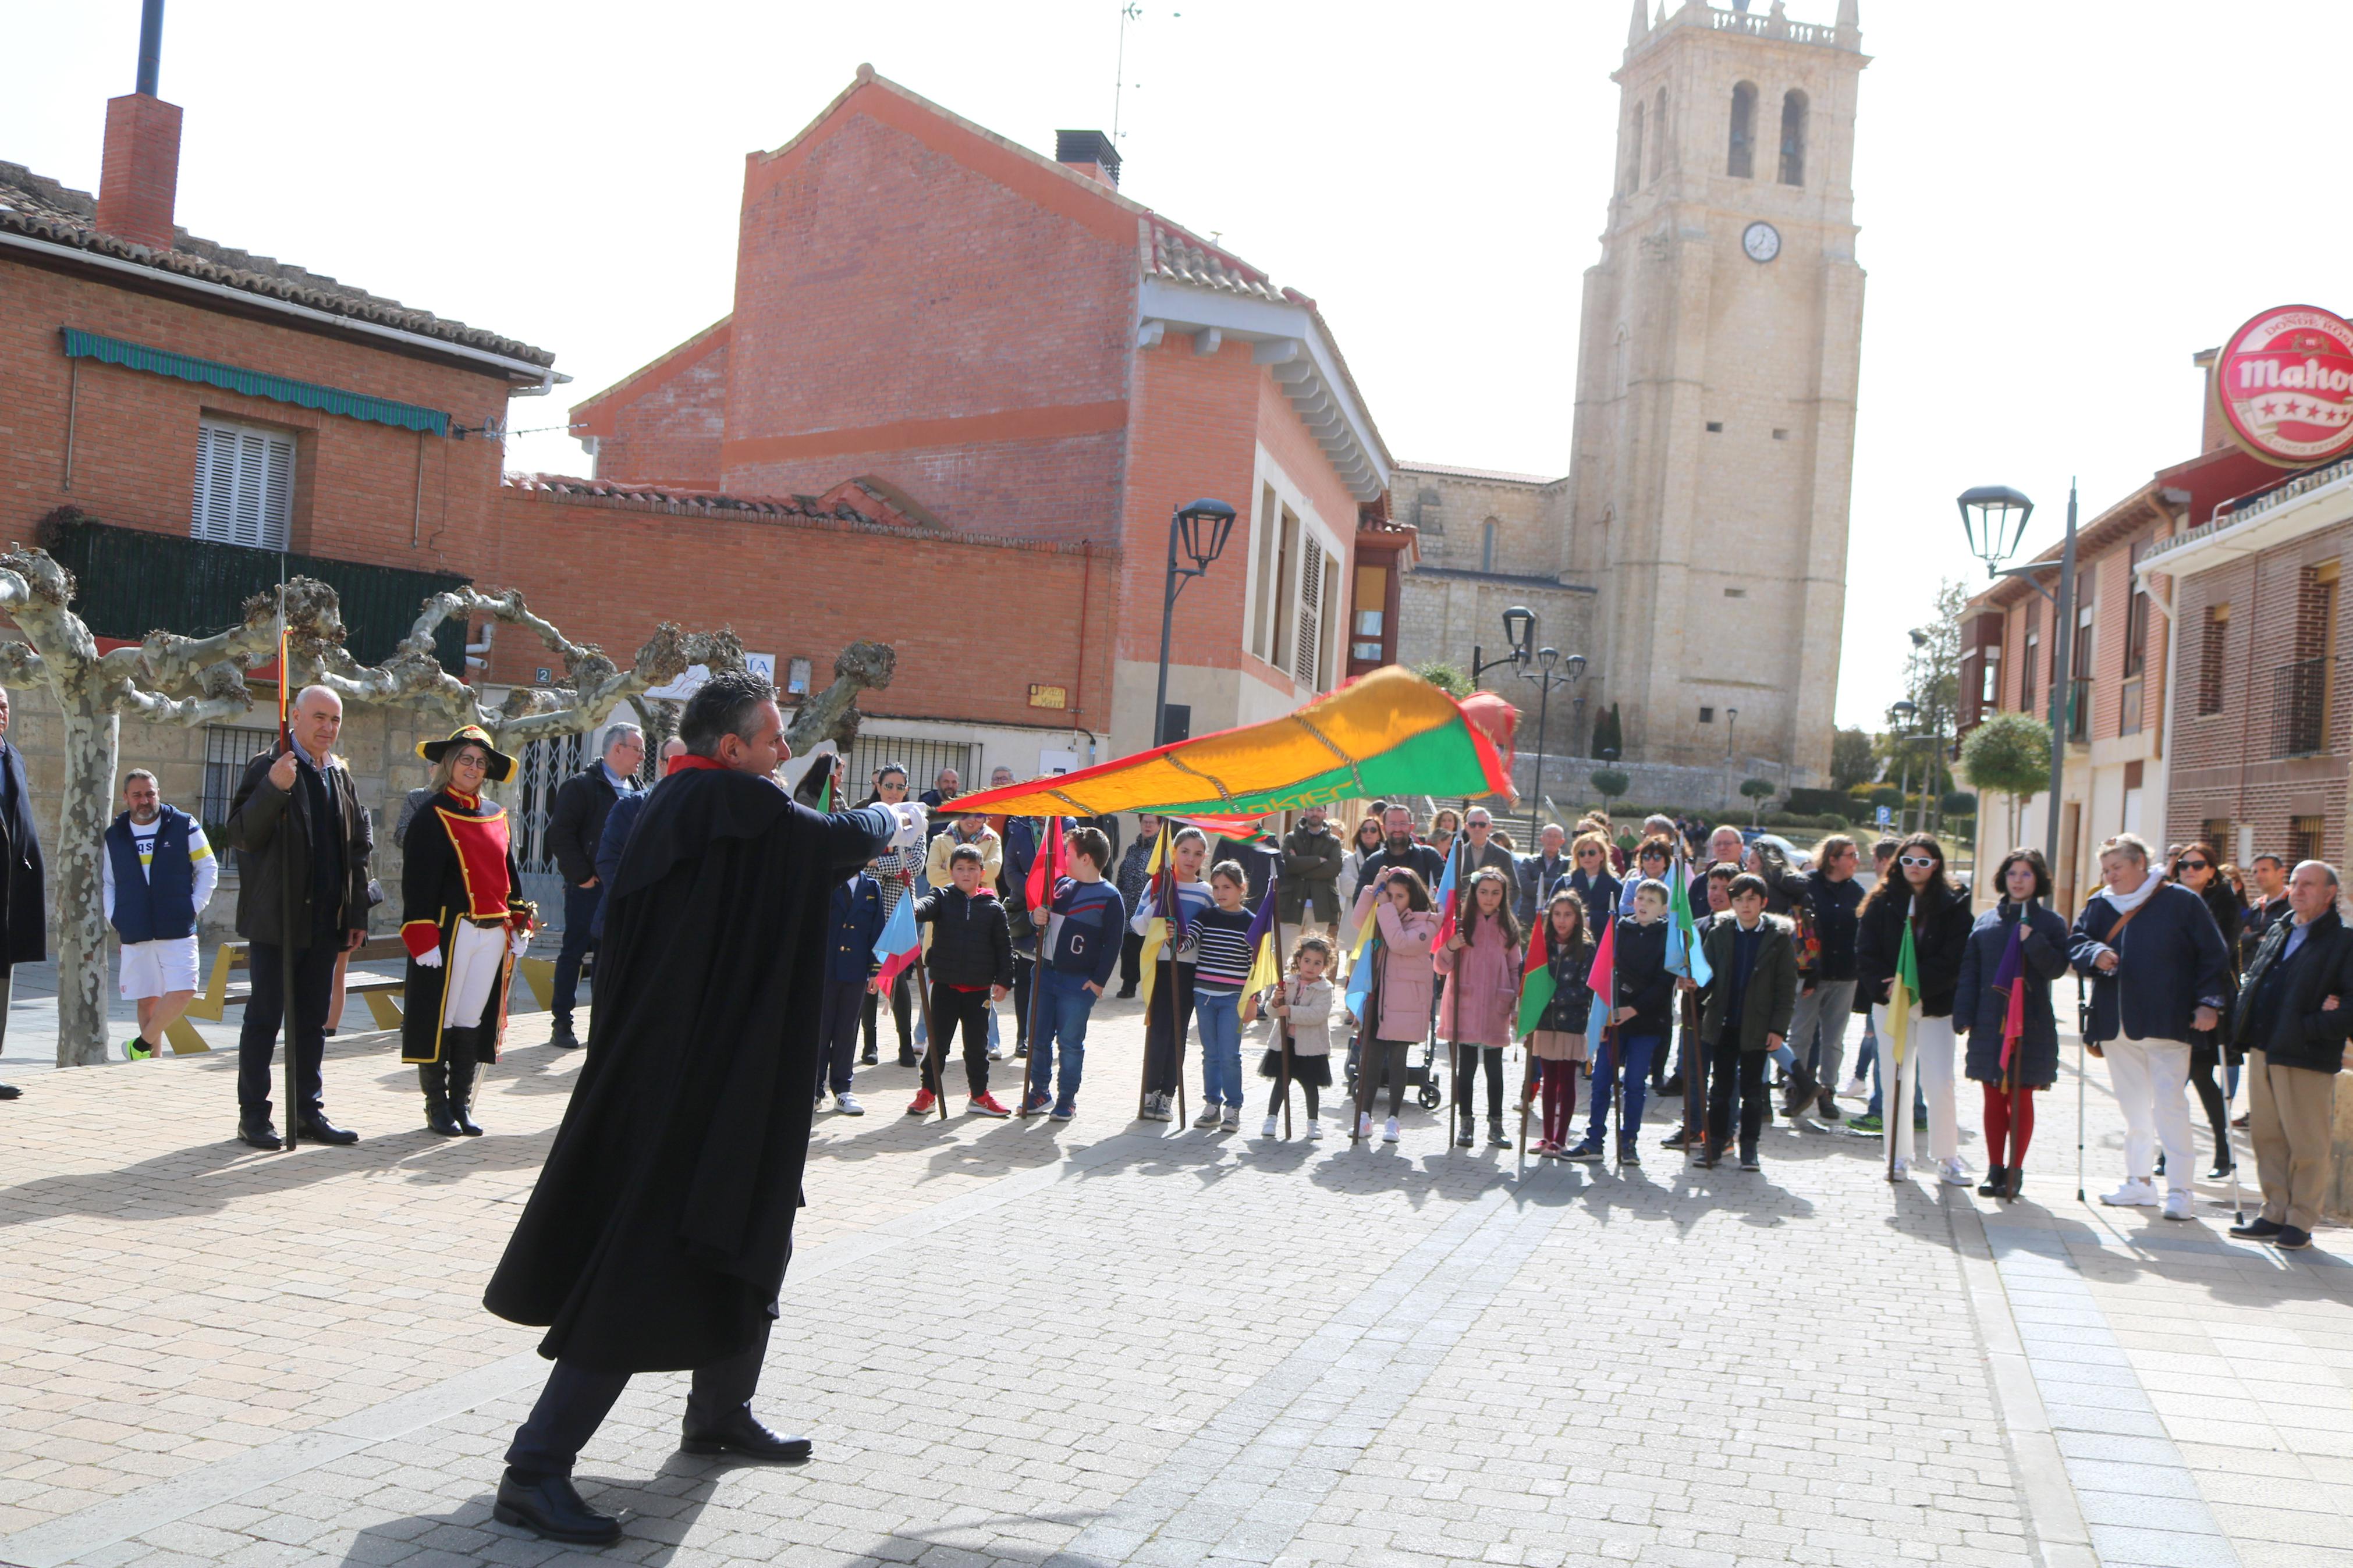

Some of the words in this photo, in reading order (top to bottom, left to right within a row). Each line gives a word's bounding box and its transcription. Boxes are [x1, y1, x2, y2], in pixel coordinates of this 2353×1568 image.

[2265, 317, 2318, 336] DONDE
[540, 670, 548, 680] 2
[1042, 687, 1063, 697] Plaza
[1039, 697, 1063, 708] Mayor
[1880, 809, 1889, 822] P
[1070, 934, 1084, 954] G
